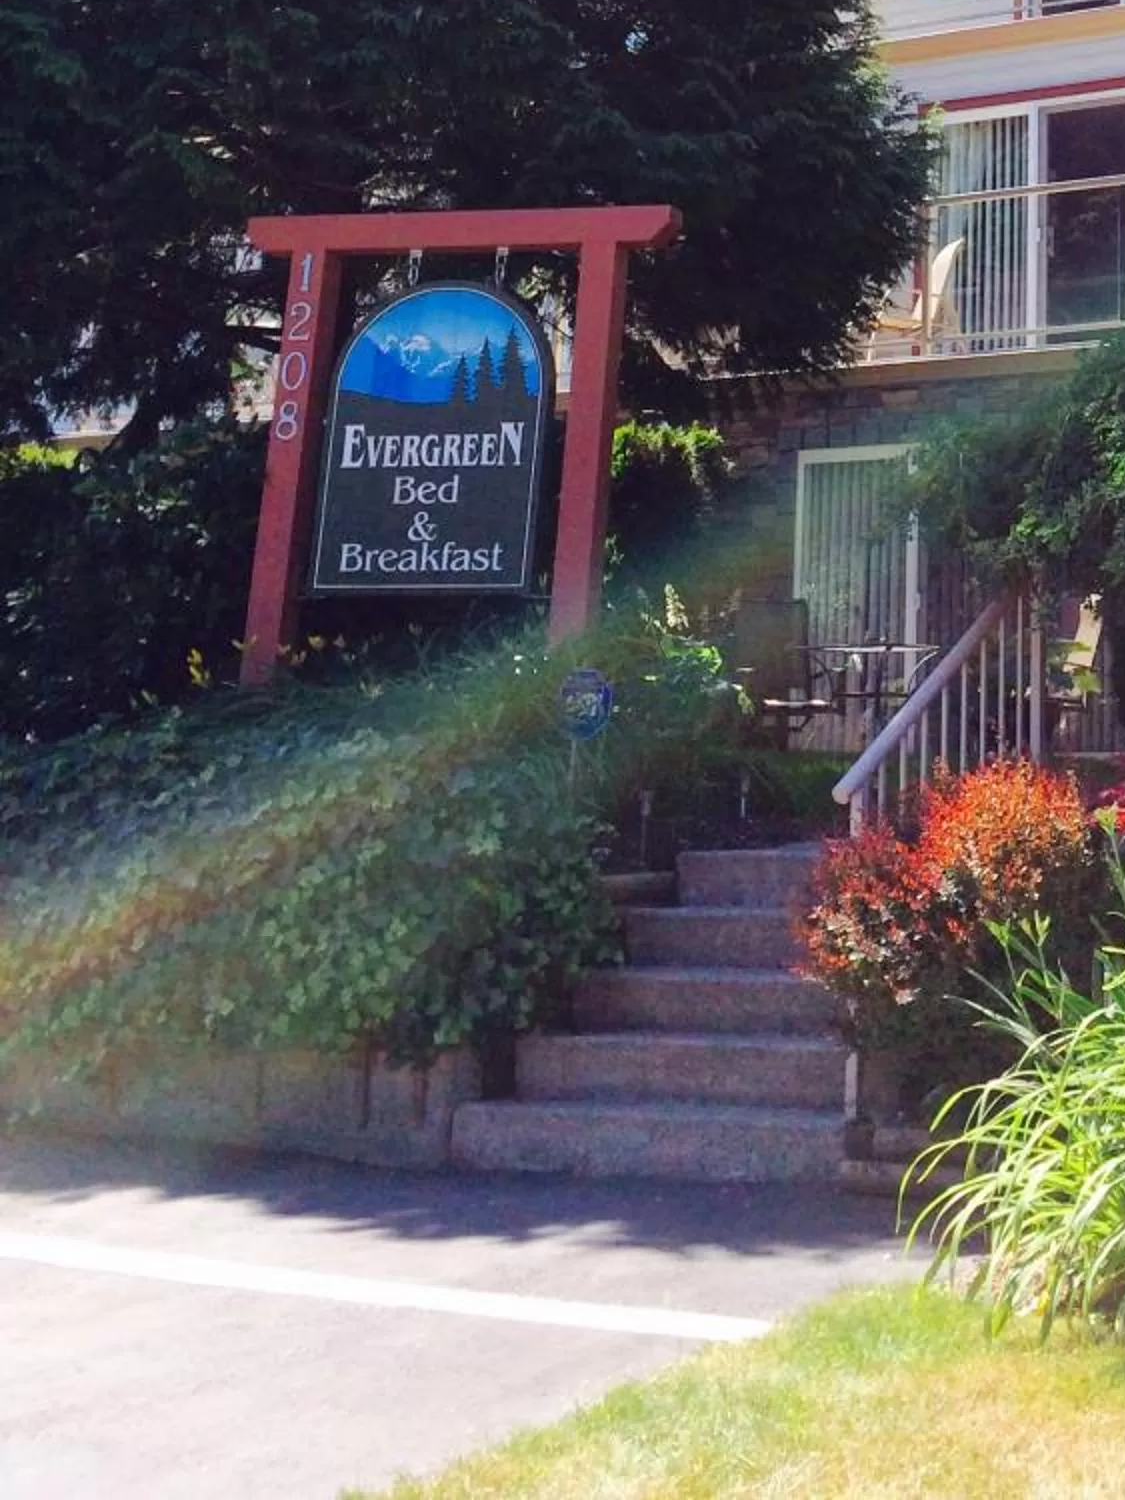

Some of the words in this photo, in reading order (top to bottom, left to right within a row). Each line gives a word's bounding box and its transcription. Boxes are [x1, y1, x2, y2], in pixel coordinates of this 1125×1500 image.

[275, 253, 314, 441] 1208
[340, 421, 525, 469] EVERGREEN
[392, 474, 460, 505] Bed
[407, 510, 438, 542] &
[339, 541, 503, 573] Breakfast
